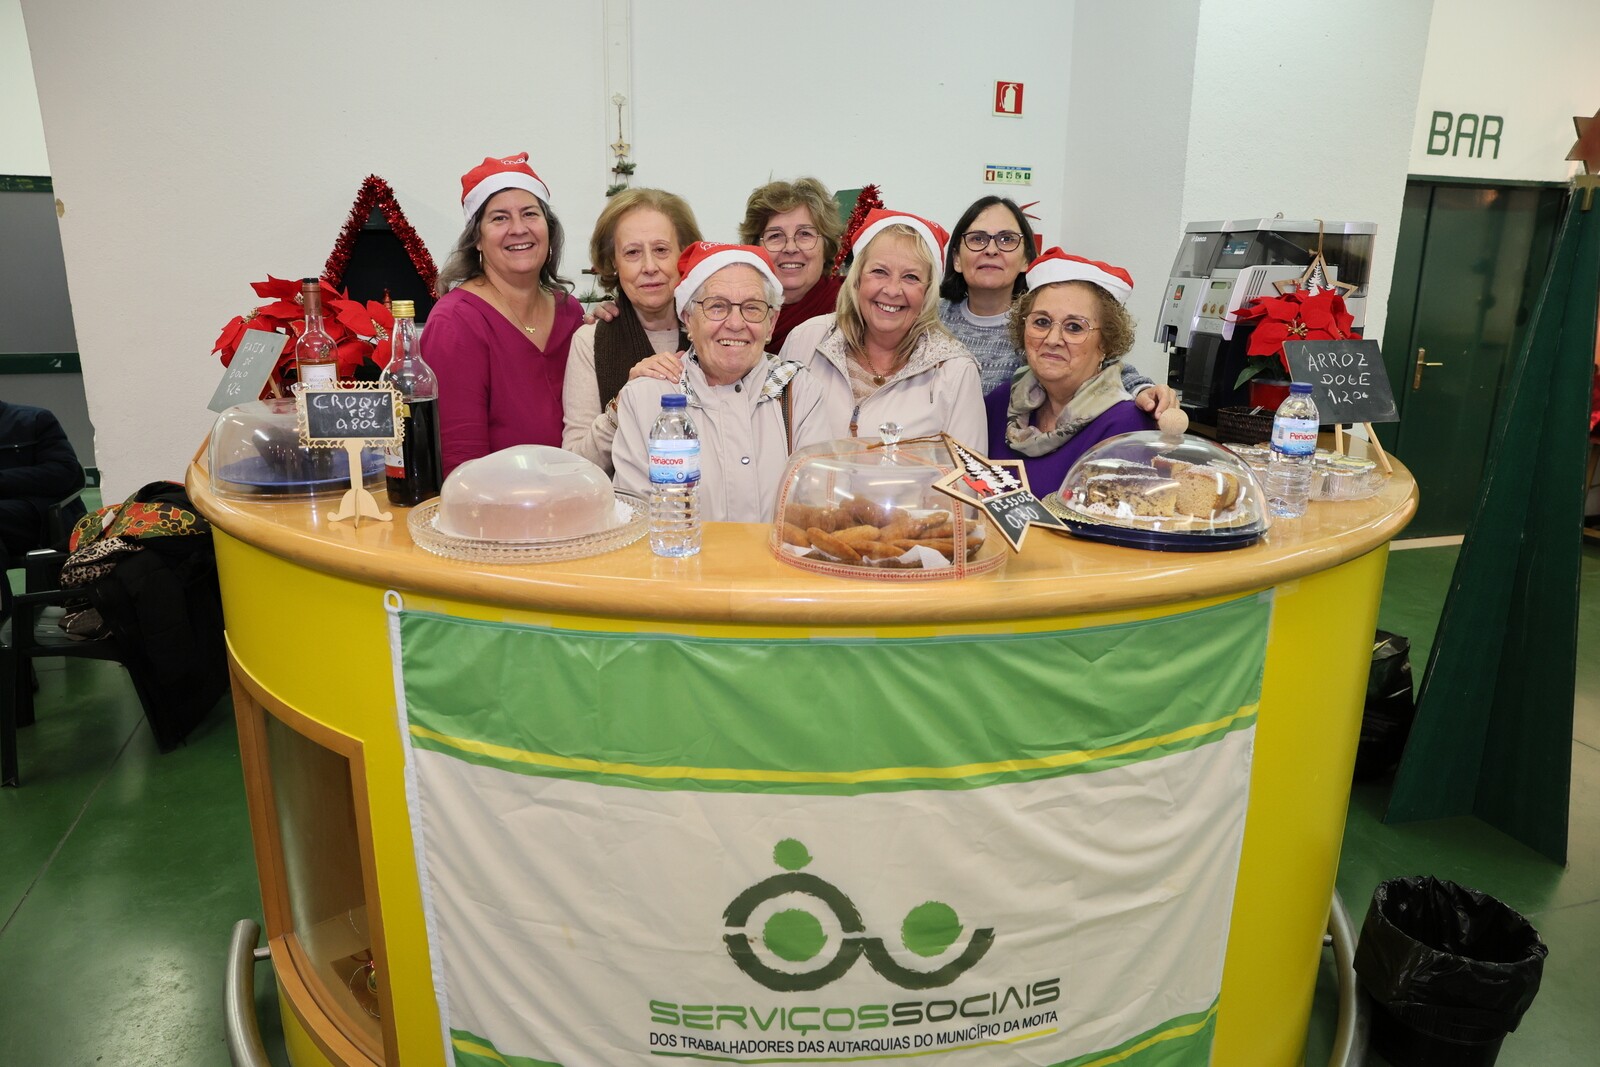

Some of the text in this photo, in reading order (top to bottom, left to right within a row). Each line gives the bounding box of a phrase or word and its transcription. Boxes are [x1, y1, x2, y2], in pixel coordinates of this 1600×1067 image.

[1427, 111, 1504, 159] BAR
[1308, 353, 1368, 372] ARROZ
[230, 369, 248, 379] BOLO
[1320, 373, 1371, 386] DOCE
[313, 394, 389, 409] CROQUE
[349, 408, 375, 419] TES
[651, 455, 684, 465] Penacova
[650, 1010, 1058, 1055] DOS TRABALHADORES DAS AUTARQUIAS DO MUNICÍPIO DA MOITA
